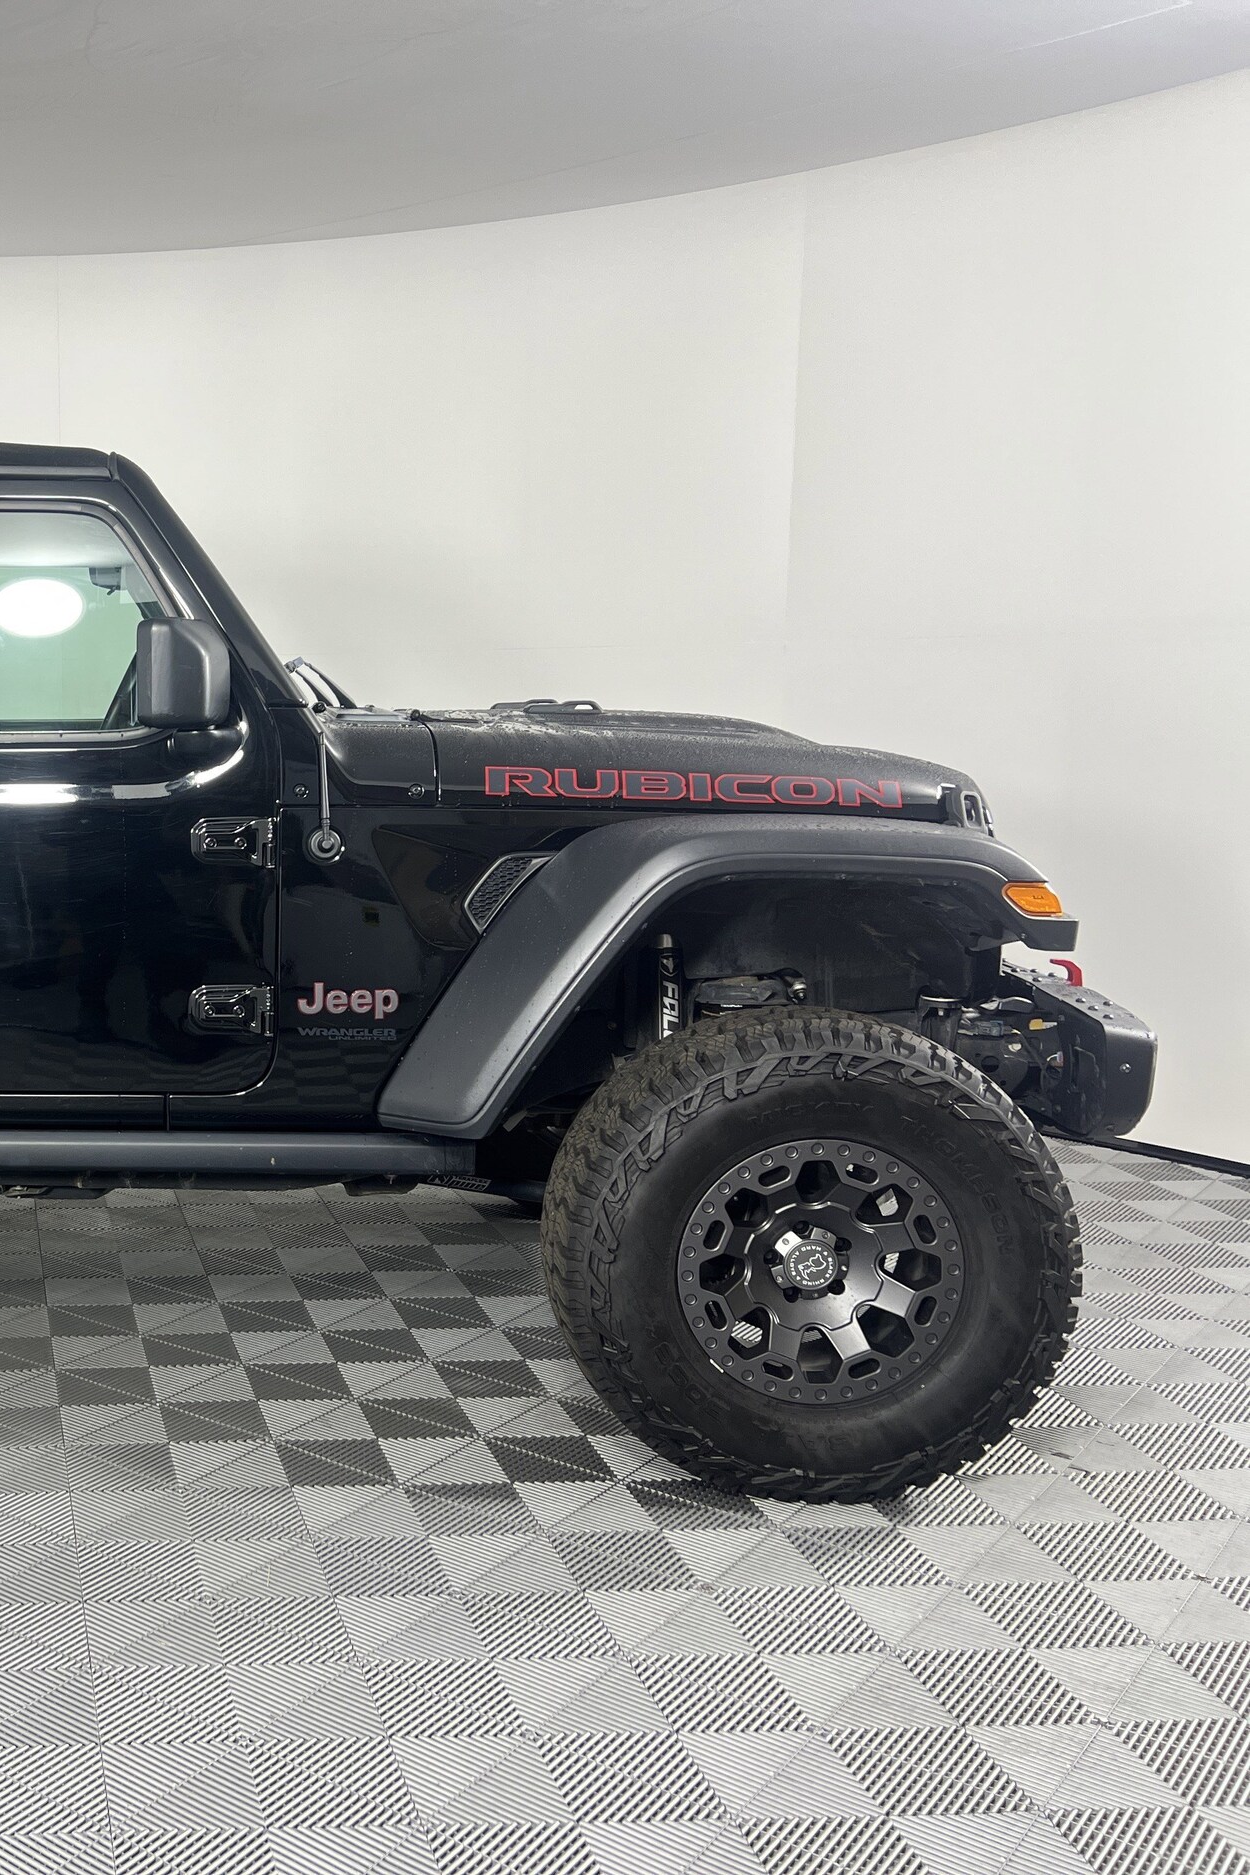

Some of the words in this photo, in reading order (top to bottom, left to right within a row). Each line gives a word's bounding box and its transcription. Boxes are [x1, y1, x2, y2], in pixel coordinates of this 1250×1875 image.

[484, 765, 903, 809] RUBICON
[297, 981, 400, 1020] Jeep
[662, 980, 680, 1038] FAL
[297, 1026, 397, 1037] WRANGLER
